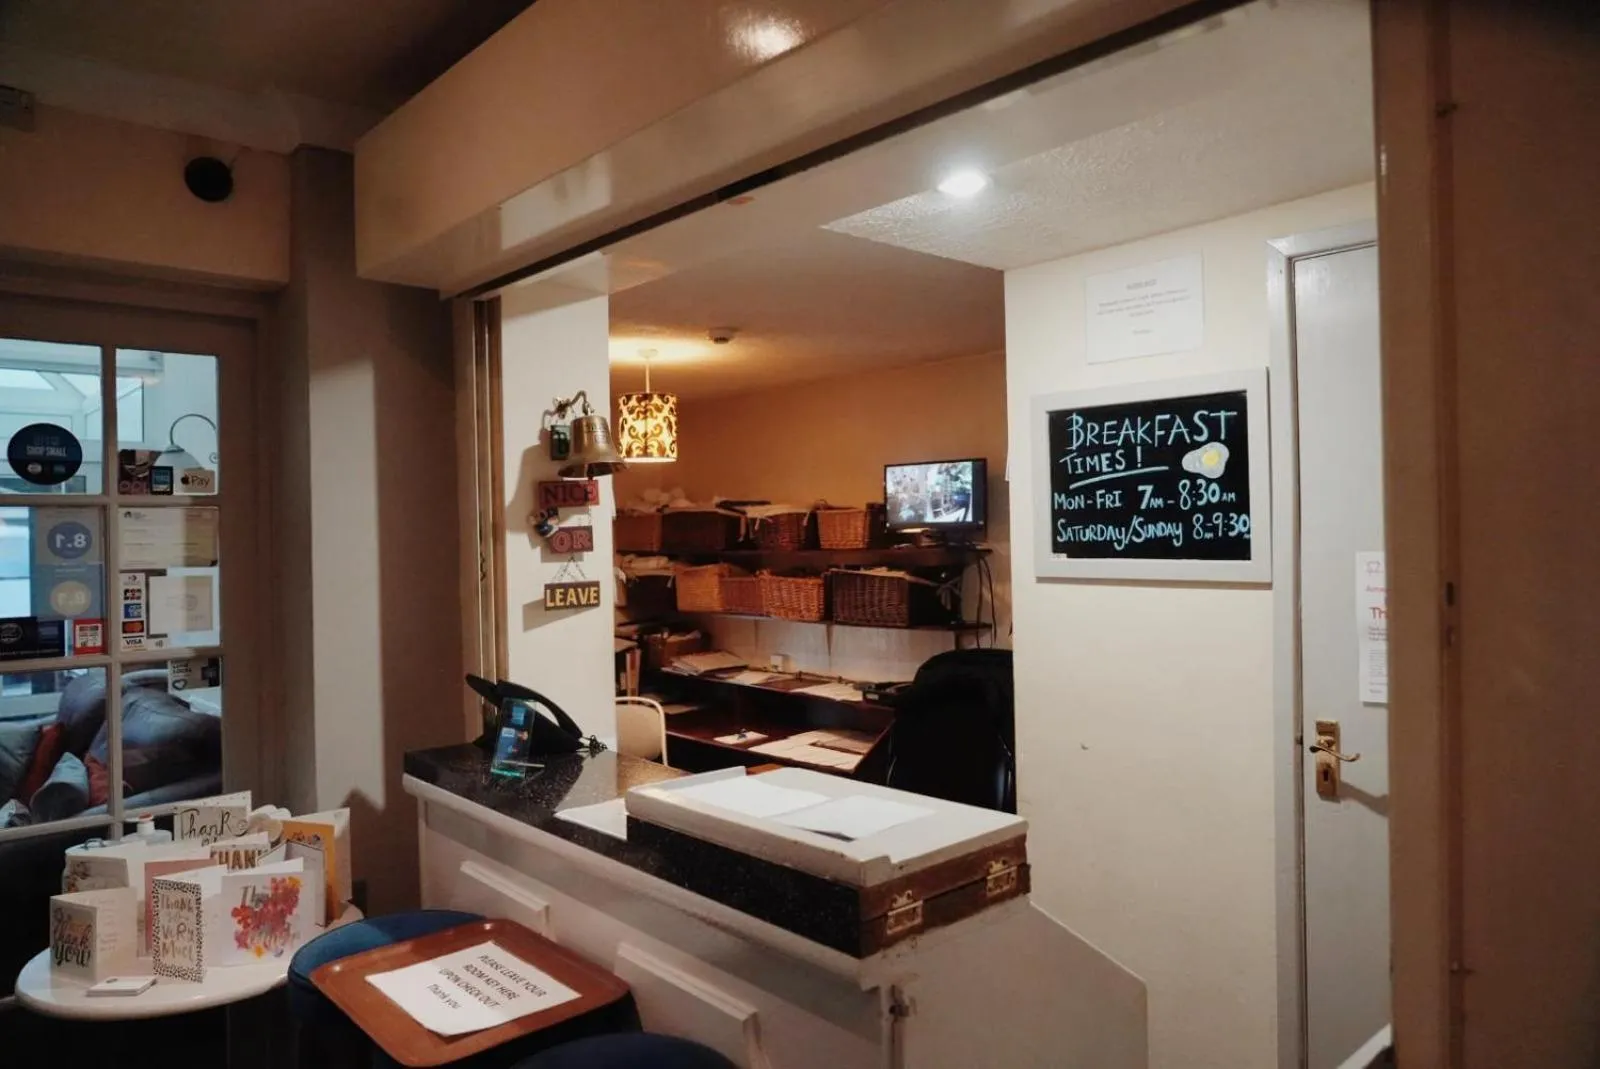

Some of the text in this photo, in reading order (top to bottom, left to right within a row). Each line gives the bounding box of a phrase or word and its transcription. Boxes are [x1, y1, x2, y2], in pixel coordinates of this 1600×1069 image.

[1067, 411, 1237, 449] BREAKFAST
[191, 475, 210, 487] Pay
[552, 531, 591, 552] OR
[545, 587, 598, 607] LEAVE
